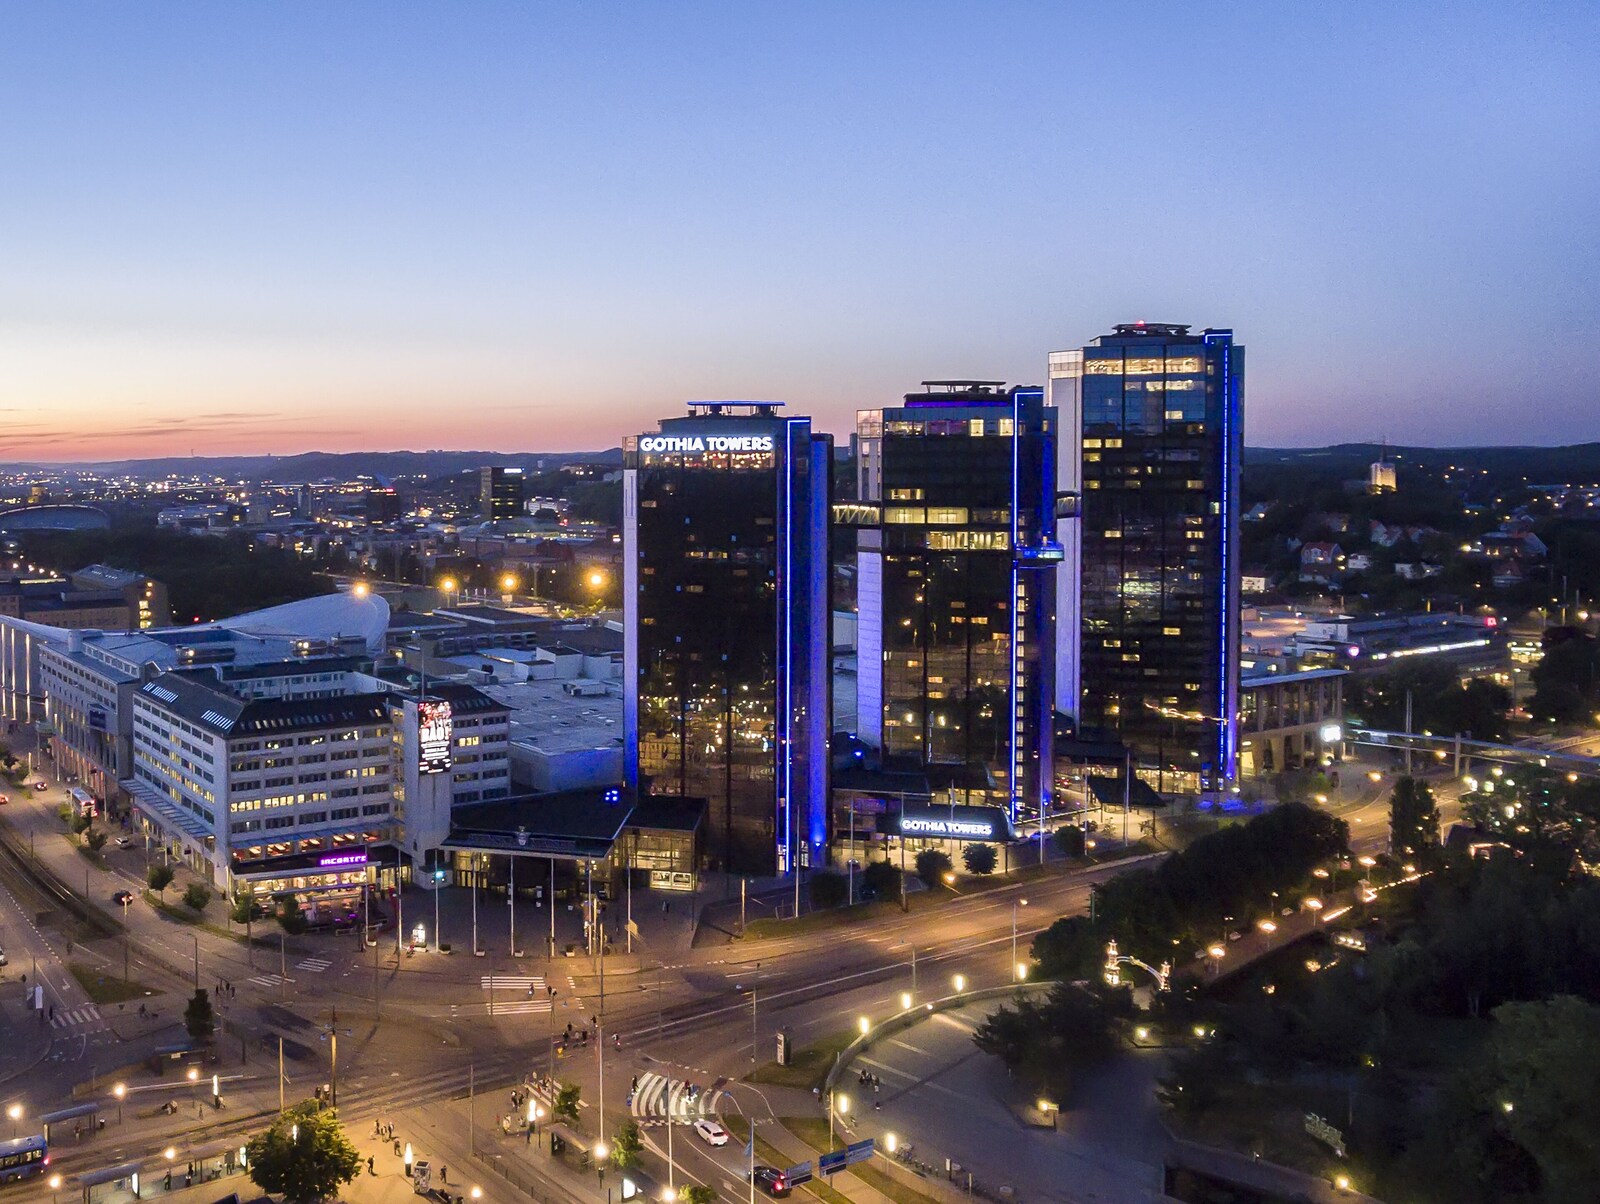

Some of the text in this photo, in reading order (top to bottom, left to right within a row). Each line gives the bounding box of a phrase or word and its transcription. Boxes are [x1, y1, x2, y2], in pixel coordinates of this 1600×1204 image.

[640, 436, 773, 452] GOTHIA TOWERS
[902, 820, 992, 835] GOTHIA TOWERS
